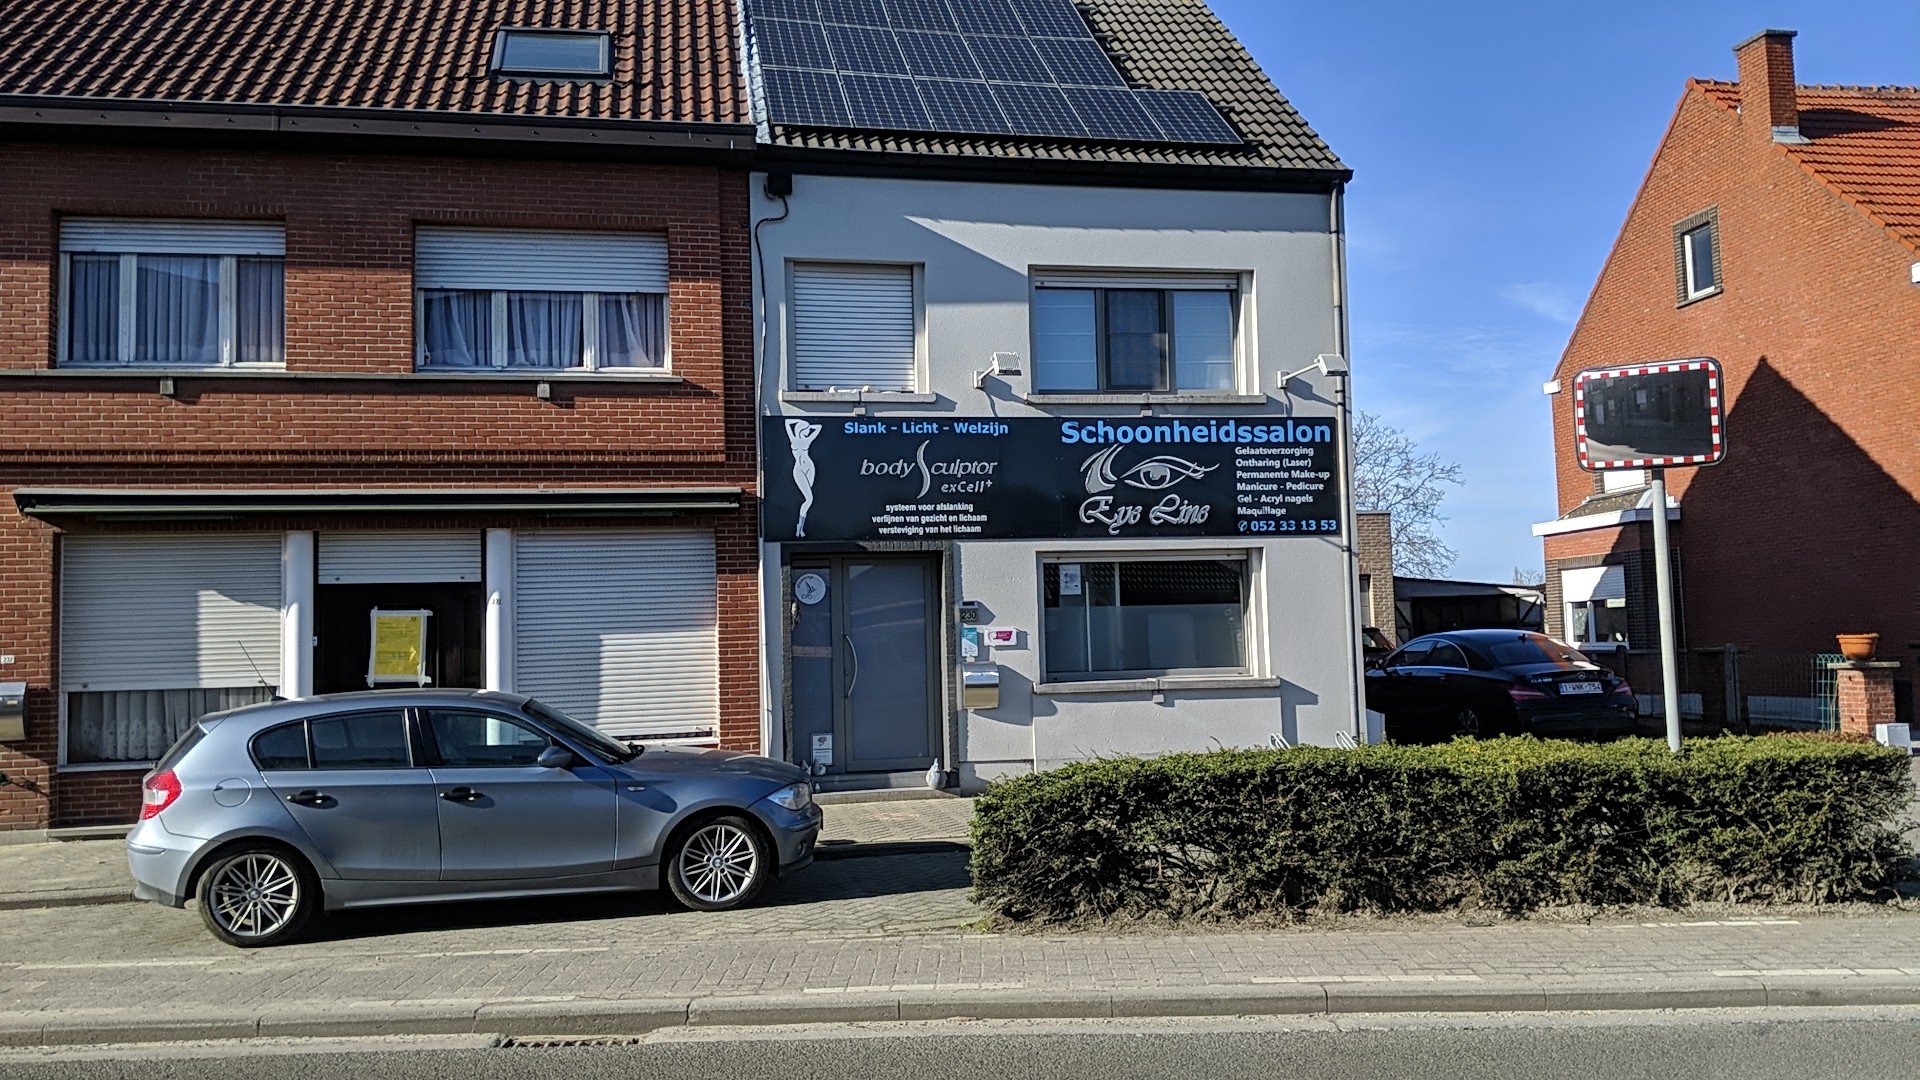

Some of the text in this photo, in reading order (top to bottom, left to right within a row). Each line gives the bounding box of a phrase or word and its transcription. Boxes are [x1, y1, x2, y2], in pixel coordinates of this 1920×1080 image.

[844, 421, 887, 434] Slank
[902, 421, 938, 434] Licht
[954, 421, 1009, 436] Welzijn
[1061, 420, 1331, 443] Schoonheidssalon
[1235, 446, 1315, 456] Gelaatsverzorging
[1236, 458, 1312, 468] Ontharing (Laser)
[1237, 470, 1330, 480] Permanente Make-up
[1237, 481, 1278, 491] Manicure
[1286, 481, 1324, 491] Pedicure
[1237, 494, 1252, 503] Gel
[1260, 493, 1283, 505] Acryl
[1285, 493, 1314, 504] nagels
[885, 503, 916, 513] systeem
[936, 502, 974, 512] afslanking
[1237, 506, 1287, 517] Maquillage
[872, 514, 904, 524] verfijnen
[921, 514, 947, 524] gezicht
[959, 514, 987, 522] lichaam
[1079, 494, 1211, 535] Eye Line
[879, 525, 923, 535] versteviging
[940, 525, 952, 533] het
[953, 525, 981, 533] lichaam
[1251, 519, 1337, 532] 052 33 13 53
[962, 611, 977, 620] 230
